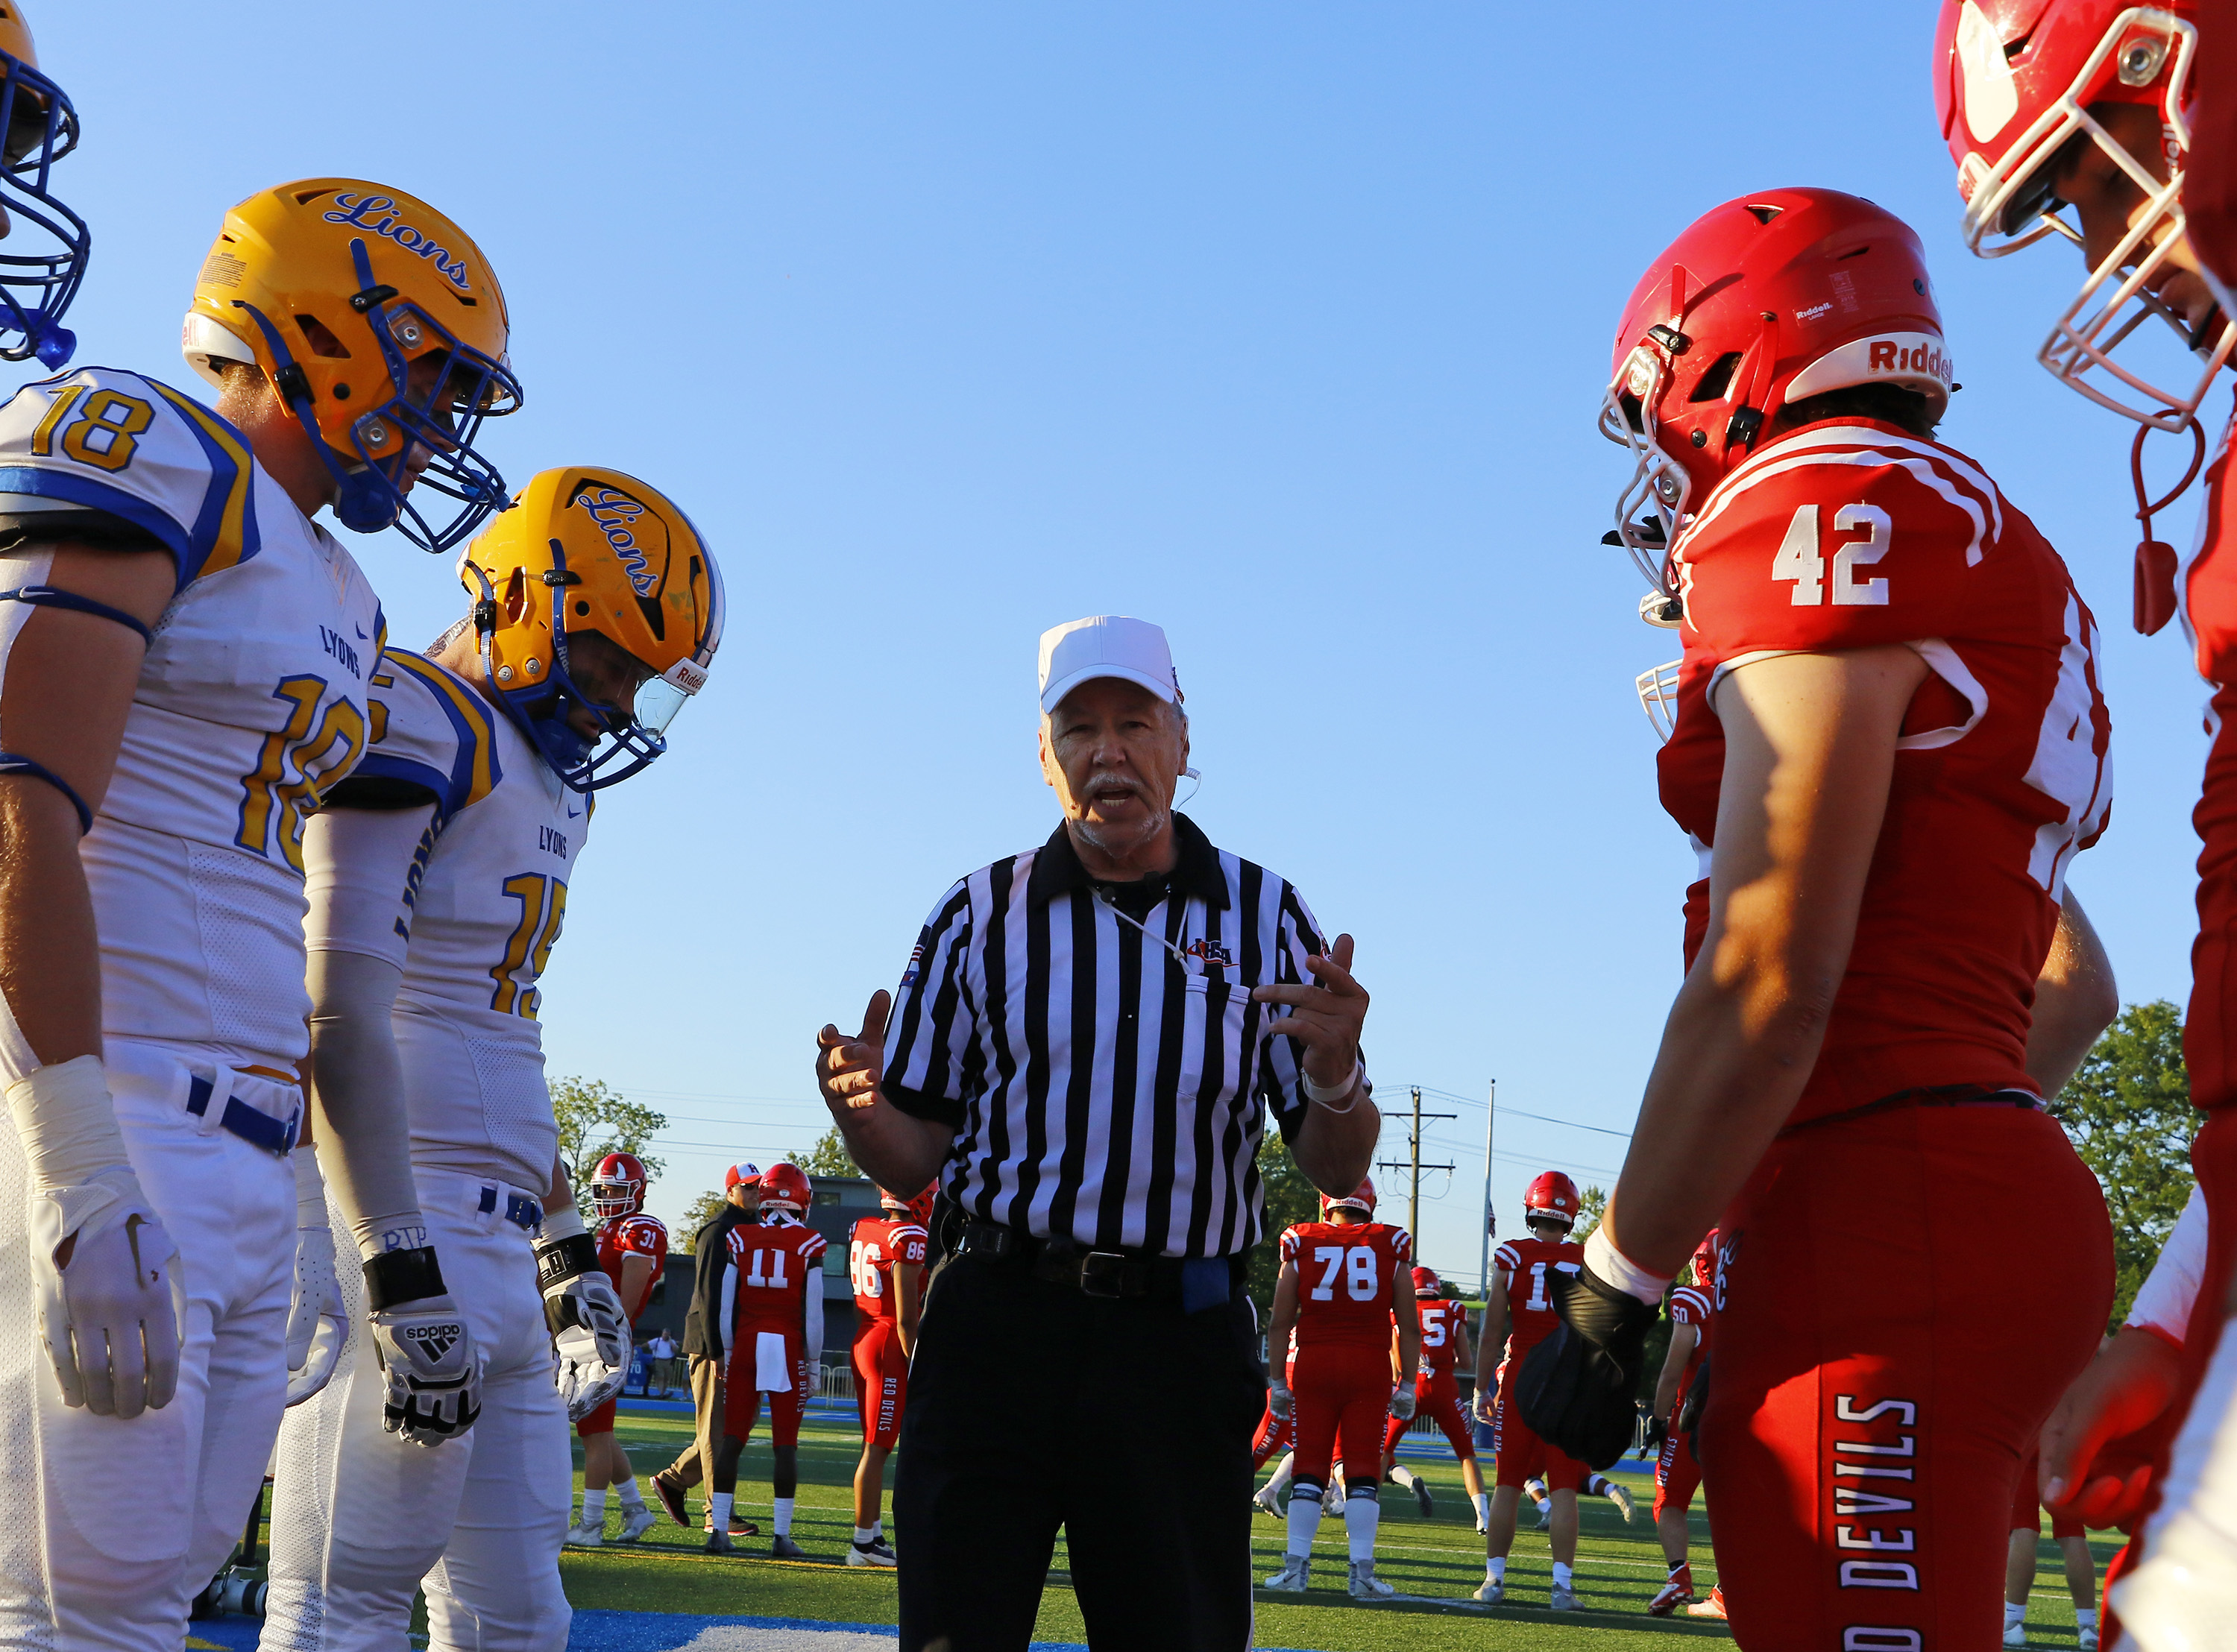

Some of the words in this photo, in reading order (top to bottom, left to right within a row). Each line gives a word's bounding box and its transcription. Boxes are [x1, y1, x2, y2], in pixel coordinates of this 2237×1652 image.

[322, 192, 472, 291] Lions
[1796, 302, 1830, 319] Riddell
[1868, 341, 1953, 398] Riddel
[31, 385, 156, 473] 18
[576, 489, 658, 597] Lions
[1772, 499, 1892, 605] 42
[318, 625, 360, 680] LYONS
[539, 825, 567, 860] LYONS
[1195, 938, 1232, 965] IHSA
[1335, 1198, 1363, 1208] Riddell
[1537, 1208, 1565, 1220] Riddell
[639, 1229, 656, 1249] 31
[906, 1241, 925, 1261] 86
[747, 1248, 787, 1289] 11
[850, 1240, 883, 1299] 86
[1311, 1246, 1378, 1301] 78
[1673, 1305, 1688, 1324] 50
[406, 1323, 461, 1340] adidas
[796, 1360, 805, 1376] RED
[796, 1381, 807, 1413] DEVILS
[884, 1378, 897, 1395] RED
[878, 1399, 895, 1431] DEVILS
[1494, 1400, 1504, 1431] DEVILS
[1494, 1434, 1502, 1451] RED
[1661, 1436, 1678, 1467] DEVILS
[1656, 1469, 1669, 1487] RED
[1834, 1395, 1922, 1591] DEVILS
